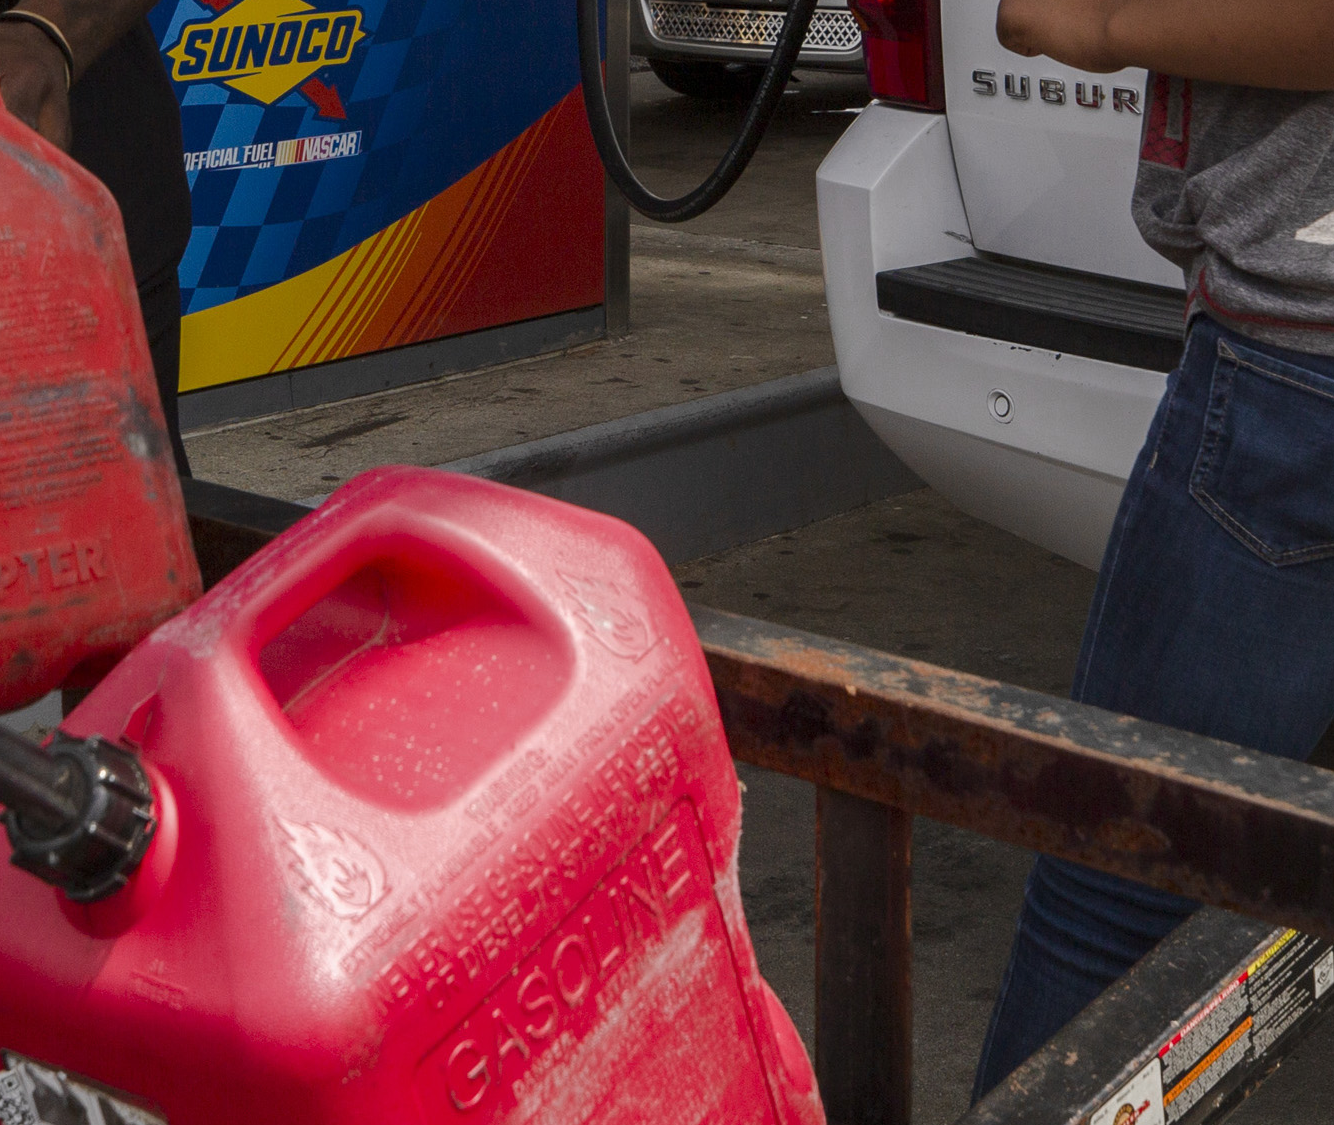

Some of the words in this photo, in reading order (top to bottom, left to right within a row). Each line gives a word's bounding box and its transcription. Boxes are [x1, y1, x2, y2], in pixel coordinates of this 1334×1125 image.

[177, 14, 358, 76] SUNOCO
[971, 68, 1142, 116] SUBUR
[183, 146, 240, 172] OFFICIAL
[243, 142, 276, 164] FUEL
[301, 132, 358, 162] NASCAR
[258, 160, 273, 170] OF
[535, 747, 581, 792] AWAY
[606, 683, 648, 725] OPEN
[465, 743, 554, 826] WARNING:
[630, 746, 686, 801] FIRE
[365, 923, 450, 1013] NEVER
[434, 881, 496, 943] USE
[443, 822, 694, 1108] GASOLINE
